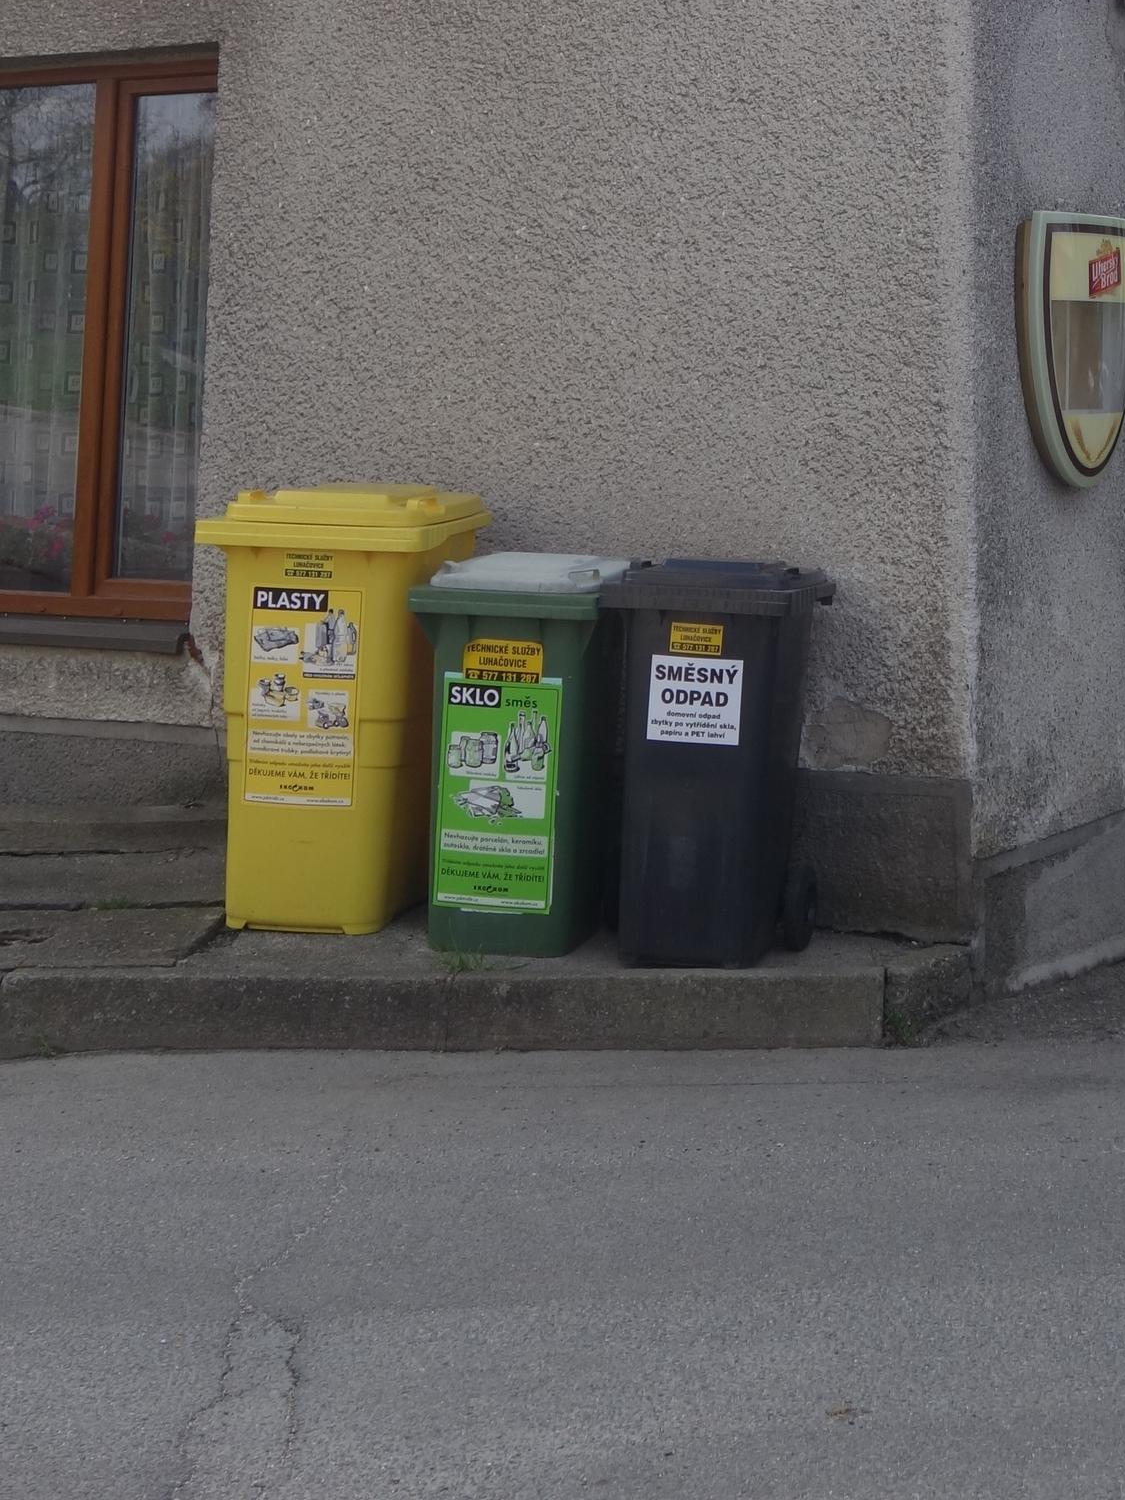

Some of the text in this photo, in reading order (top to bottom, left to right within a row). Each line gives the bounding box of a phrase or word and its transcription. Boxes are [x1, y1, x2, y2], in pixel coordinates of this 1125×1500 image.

[1100, 269, 1118, 288] Brod
[256, 590, 326, 611] PLASTY
[467, 643, 541, 656] TECHNICKÉ SLUŽBY
[478, 655, 528, 669] LUHAČOVICE
[482, 671, 537, 683] 577 131 287
[655, 662, 739, 685] SMĚSNÝ
[450, 685, 538, 708] SKLO směs
[661, 687, 729, 707] ODPAD
[651, 718, 673, 727] zbytky
[666, 710, 721, 721] domovní odpad
[660, 729, 683, 737] papíru
[691, 729, 705, 738] PET
[707, 730, 726, 739] lahví
[249, 767, 286, 778] DĚKUJEME
[441, 867, 480, 878] DĚKUJEME
[503, 871, 513, 881] ŽE
